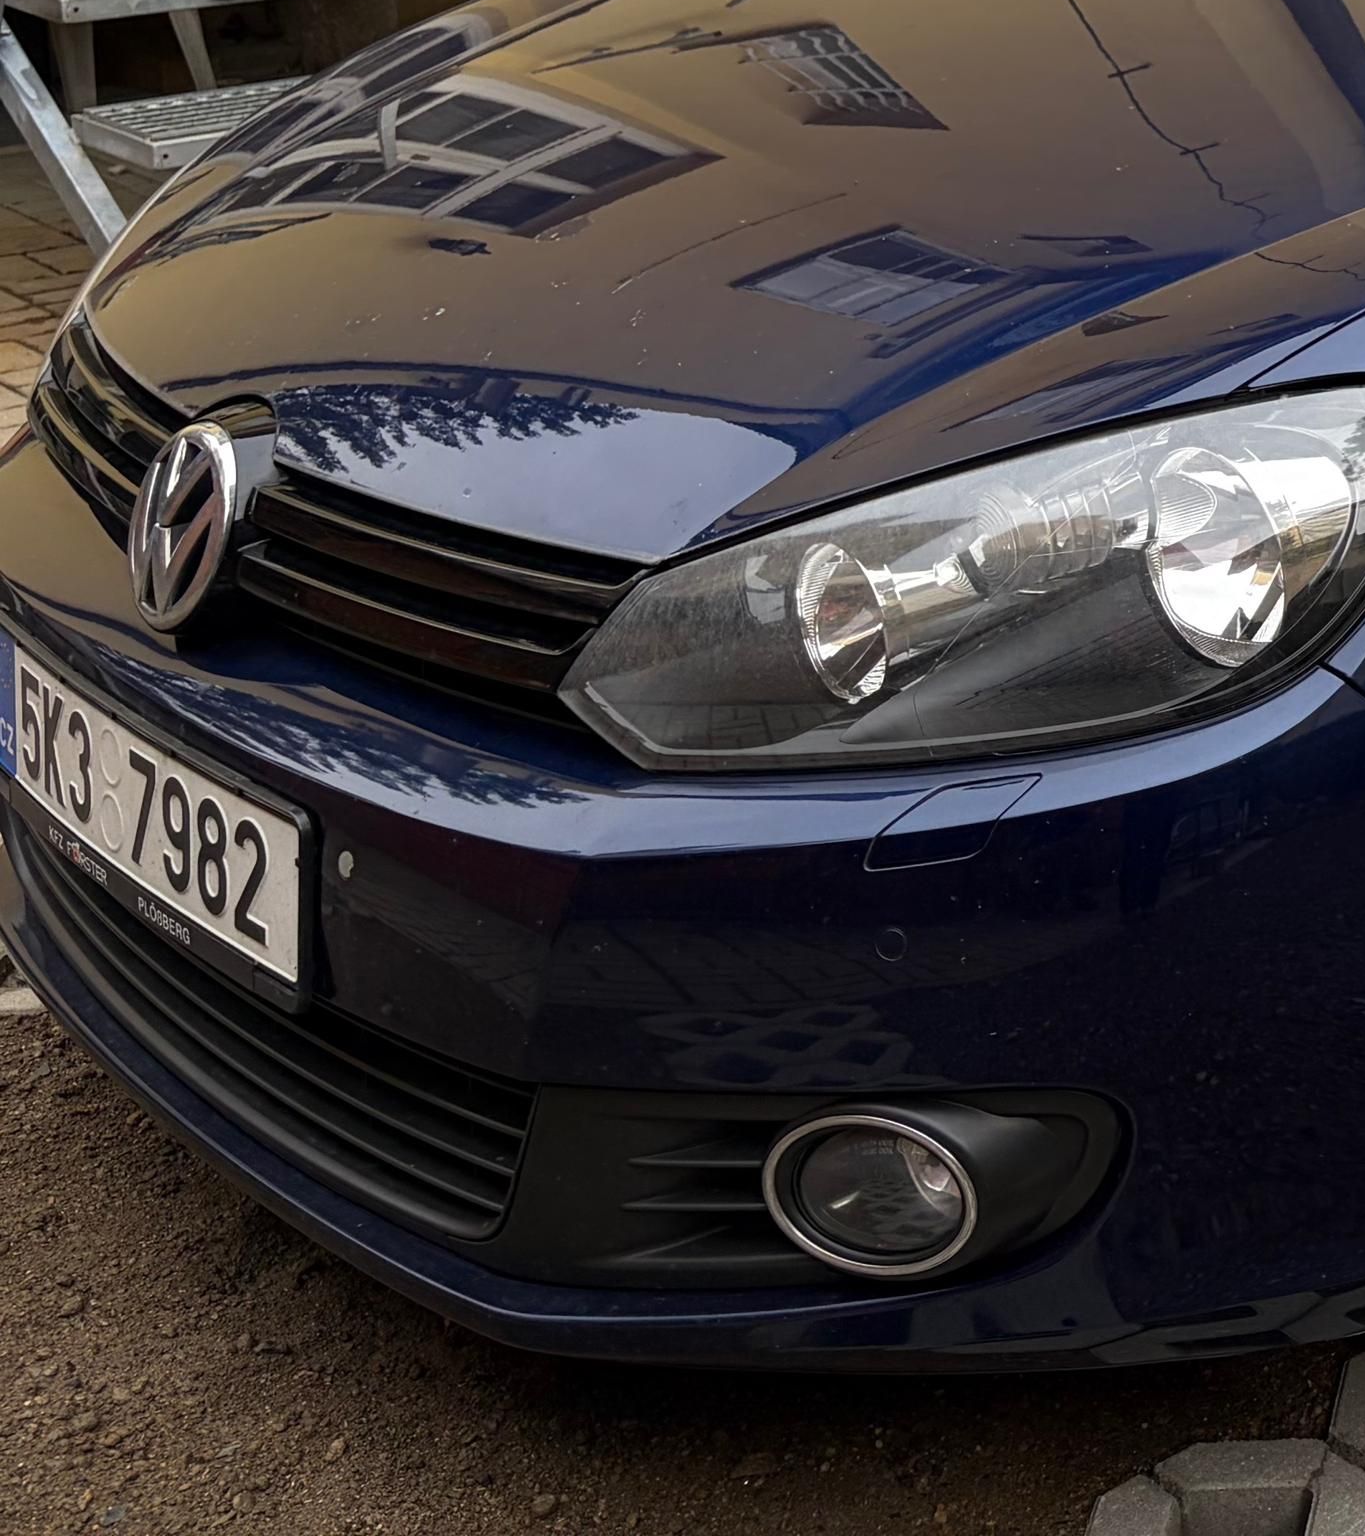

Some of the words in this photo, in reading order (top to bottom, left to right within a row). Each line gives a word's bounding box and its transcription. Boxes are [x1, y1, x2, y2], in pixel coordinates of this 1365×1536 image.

[21, 664, 93, 823] 5K3
[128, 746, 270, 949] 7982
[48, 825, 64, 850] KFZ
